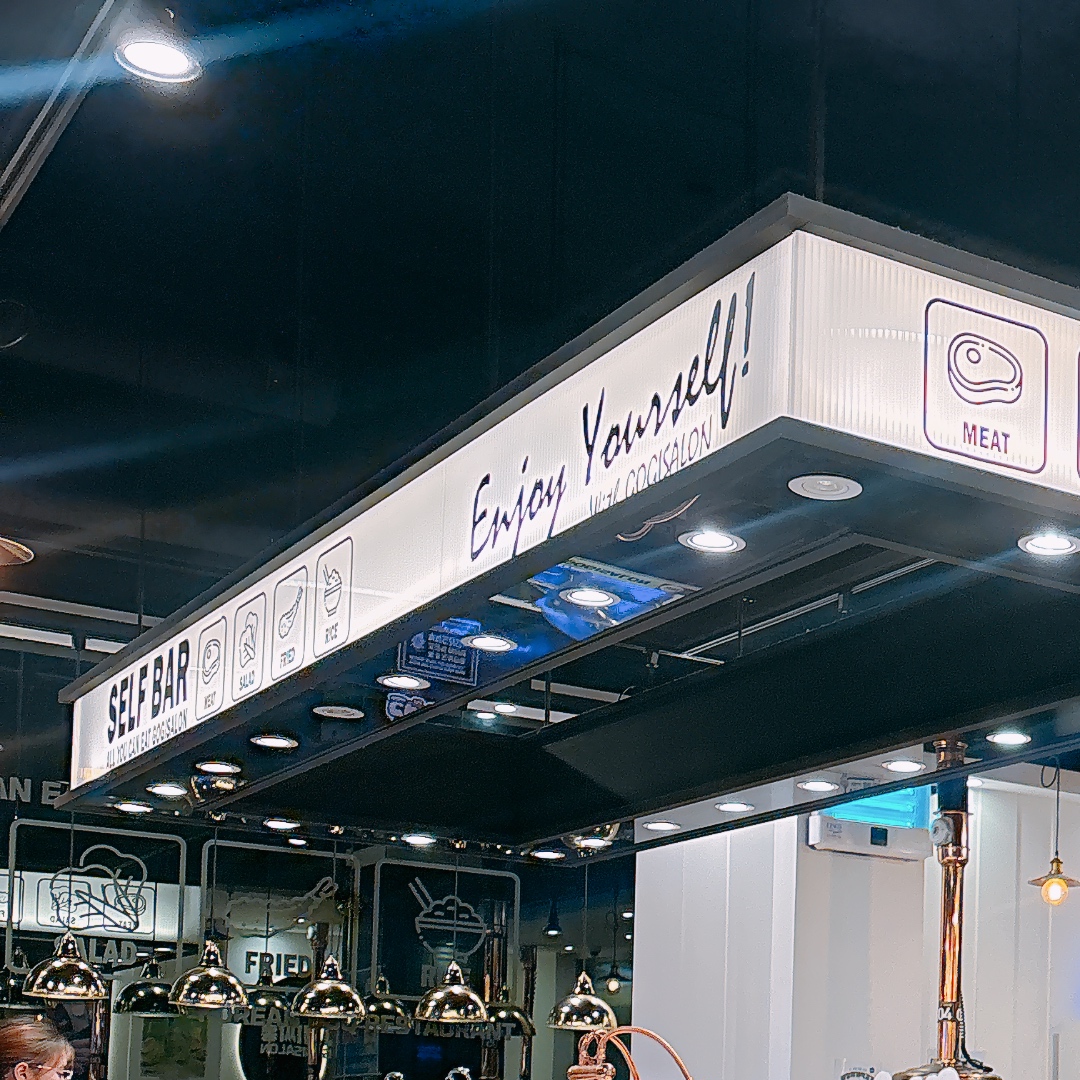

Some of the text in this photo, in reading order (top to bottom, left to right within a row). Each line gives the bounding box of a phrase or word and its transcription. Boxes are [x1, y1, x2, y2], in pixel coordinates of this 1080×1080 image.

[470, 271, 755, 562] Enjoy Yourself!
[962, 420, 1010, 455] MEAT
[107, 638, 190, 744] SELF BAR
[244, 951, 312, 979] FRIED
